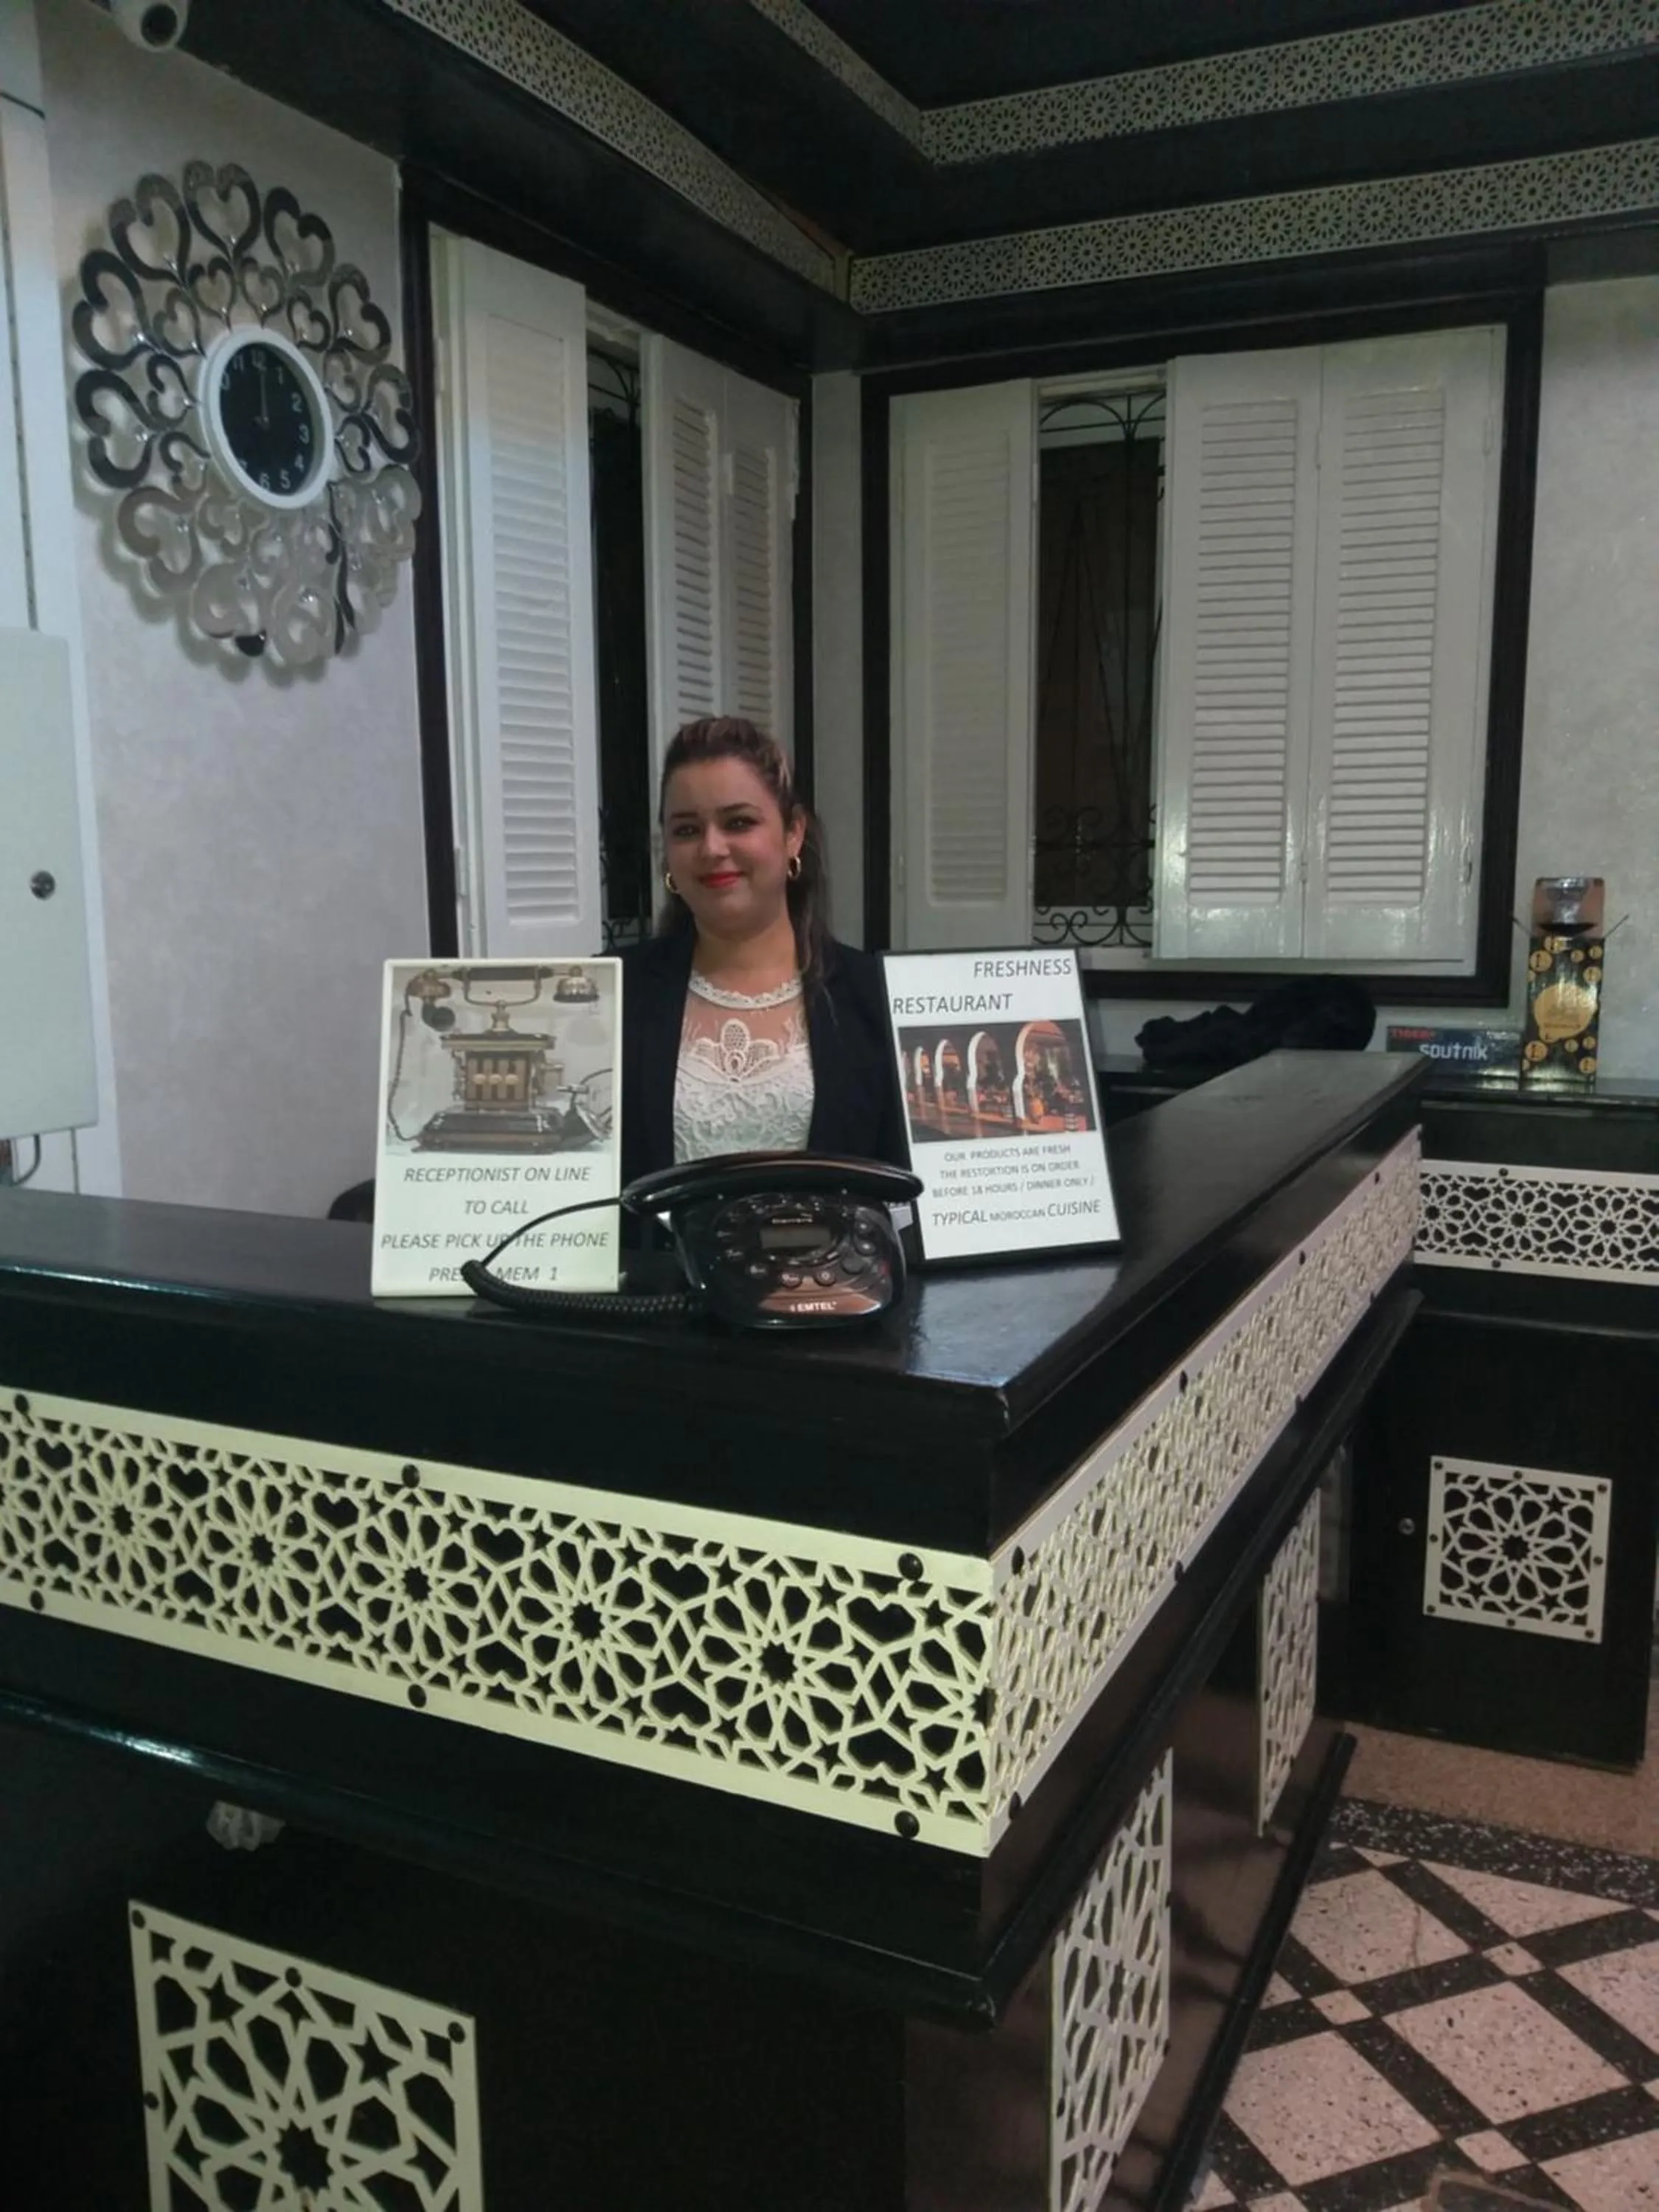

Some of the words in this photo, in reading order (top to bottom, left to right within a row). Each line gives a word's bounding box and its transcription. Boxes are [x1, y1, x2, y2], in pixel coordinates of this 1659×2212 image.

[291, 392, 302, 413] 2
[299, 424, 310, 443] 3
[294, 454, 305, 472] 4
[279, 468, 291, 489] 5
[973, 958, 1072, 978] FRESHNESS
[892, 993, 1013, 1015] RESTAURANT
[944, 1151, 966, 1163] OUR
[970, 1147, 1021, 1161] PRODUCTS
[1022, 1147, 1040, 1157] ARE
[1043, 1144, 1071, 1155] FRESH
[403, 1166, 521, 1182] RECEPTIONIST
[524, 1166, 551, 1181] ON
[554, 1166, 592, 1181] LINE
[940, 1169, 958, 1180] THE
[1020, 1162, 1030, 1174] IS
[1031, 1161, 1046, 1173] ON
[1048, 1160, 1080, 1172] ORDER
[932, 1186, 969, 1199] BEFORE
[985, 1181, 1018, 1194] HOURS
[1026, 1178, 1062, 1192] DINNER
[1063, 1176, 1088, 1189] ONLY
[464, 1200, 486, 1215] TO
[490, 1200, 530, 1215] CALL
[931, 1210, 989, 1227] TYPICAL
[990, 1208, 1046, 1222] MOROCCAN
[1047, 1198, 1102, 1217] CUISINE
[380, 1233, 440, 1249] PLEASE
[445, 1232, 482, 1248] PICK
[550, 1232, 610, 1247] PHONE
[495, 1267, 540, 1281] MEM
[549, 1267, 558, 1281] 1
